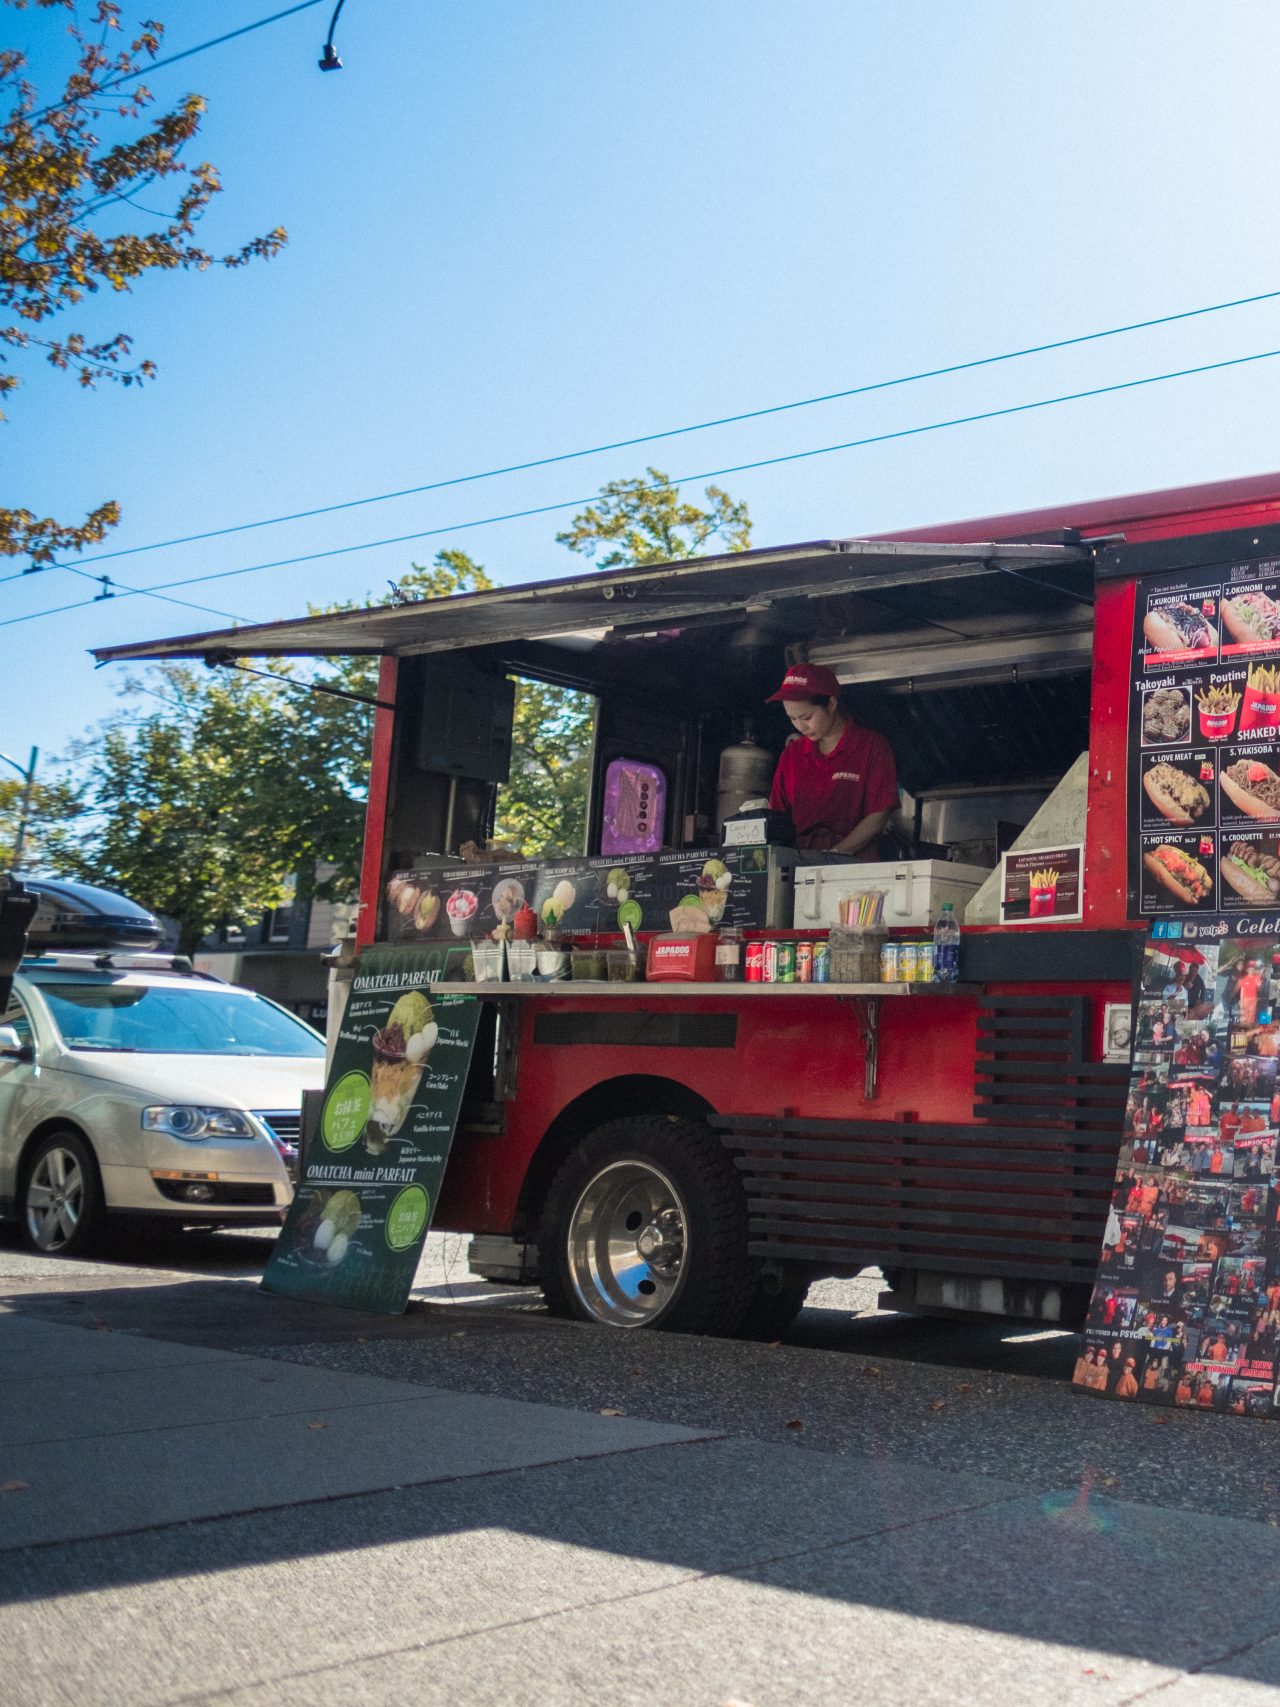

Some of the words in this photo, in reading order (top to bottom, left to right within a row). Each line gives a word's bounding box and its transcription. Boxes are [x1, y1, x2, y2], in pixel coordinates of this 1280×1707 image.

[1189, 589, 1221, 601] TERIMAYO
[1210, 670, 1247, 684] Poutine
[1135, 675, 1176, 692] Takoyaki
[1237, 725, 1276, 741] SHAKED
[1237, 745, 1273, 756] YAKISOBA
[1150, 755, 1157, 763] 4.
[1157, 754, 1174, 762] LOVE
[1174, 752, 1192, 760] MEAT
[1143, 837, 1150, 845] 7.
[1150, 836, 1163, 844] HOT
[1165, 835, 1183, 843] SPICY
[1228, 833, 1264, 842] CROQUETTE
[686, 850, 709, 860] PARFAIT
[1199, 924, 1220, 938] yelp
[655, 945, 690, 955] JAPADOG
[353, 973, 399, 990] OMATCHA
[400, 970, 441, 986] PARFAIT
[307, 1164, 351, 1179] OMATCHA
[353, 1167, 375, 1179] mini
[375, 1168, 417, 1182] PARFAIT
[1119, 1330, 1144, 1340] PSYCH
[1207, 1364, 1239, 1375] MORNING
